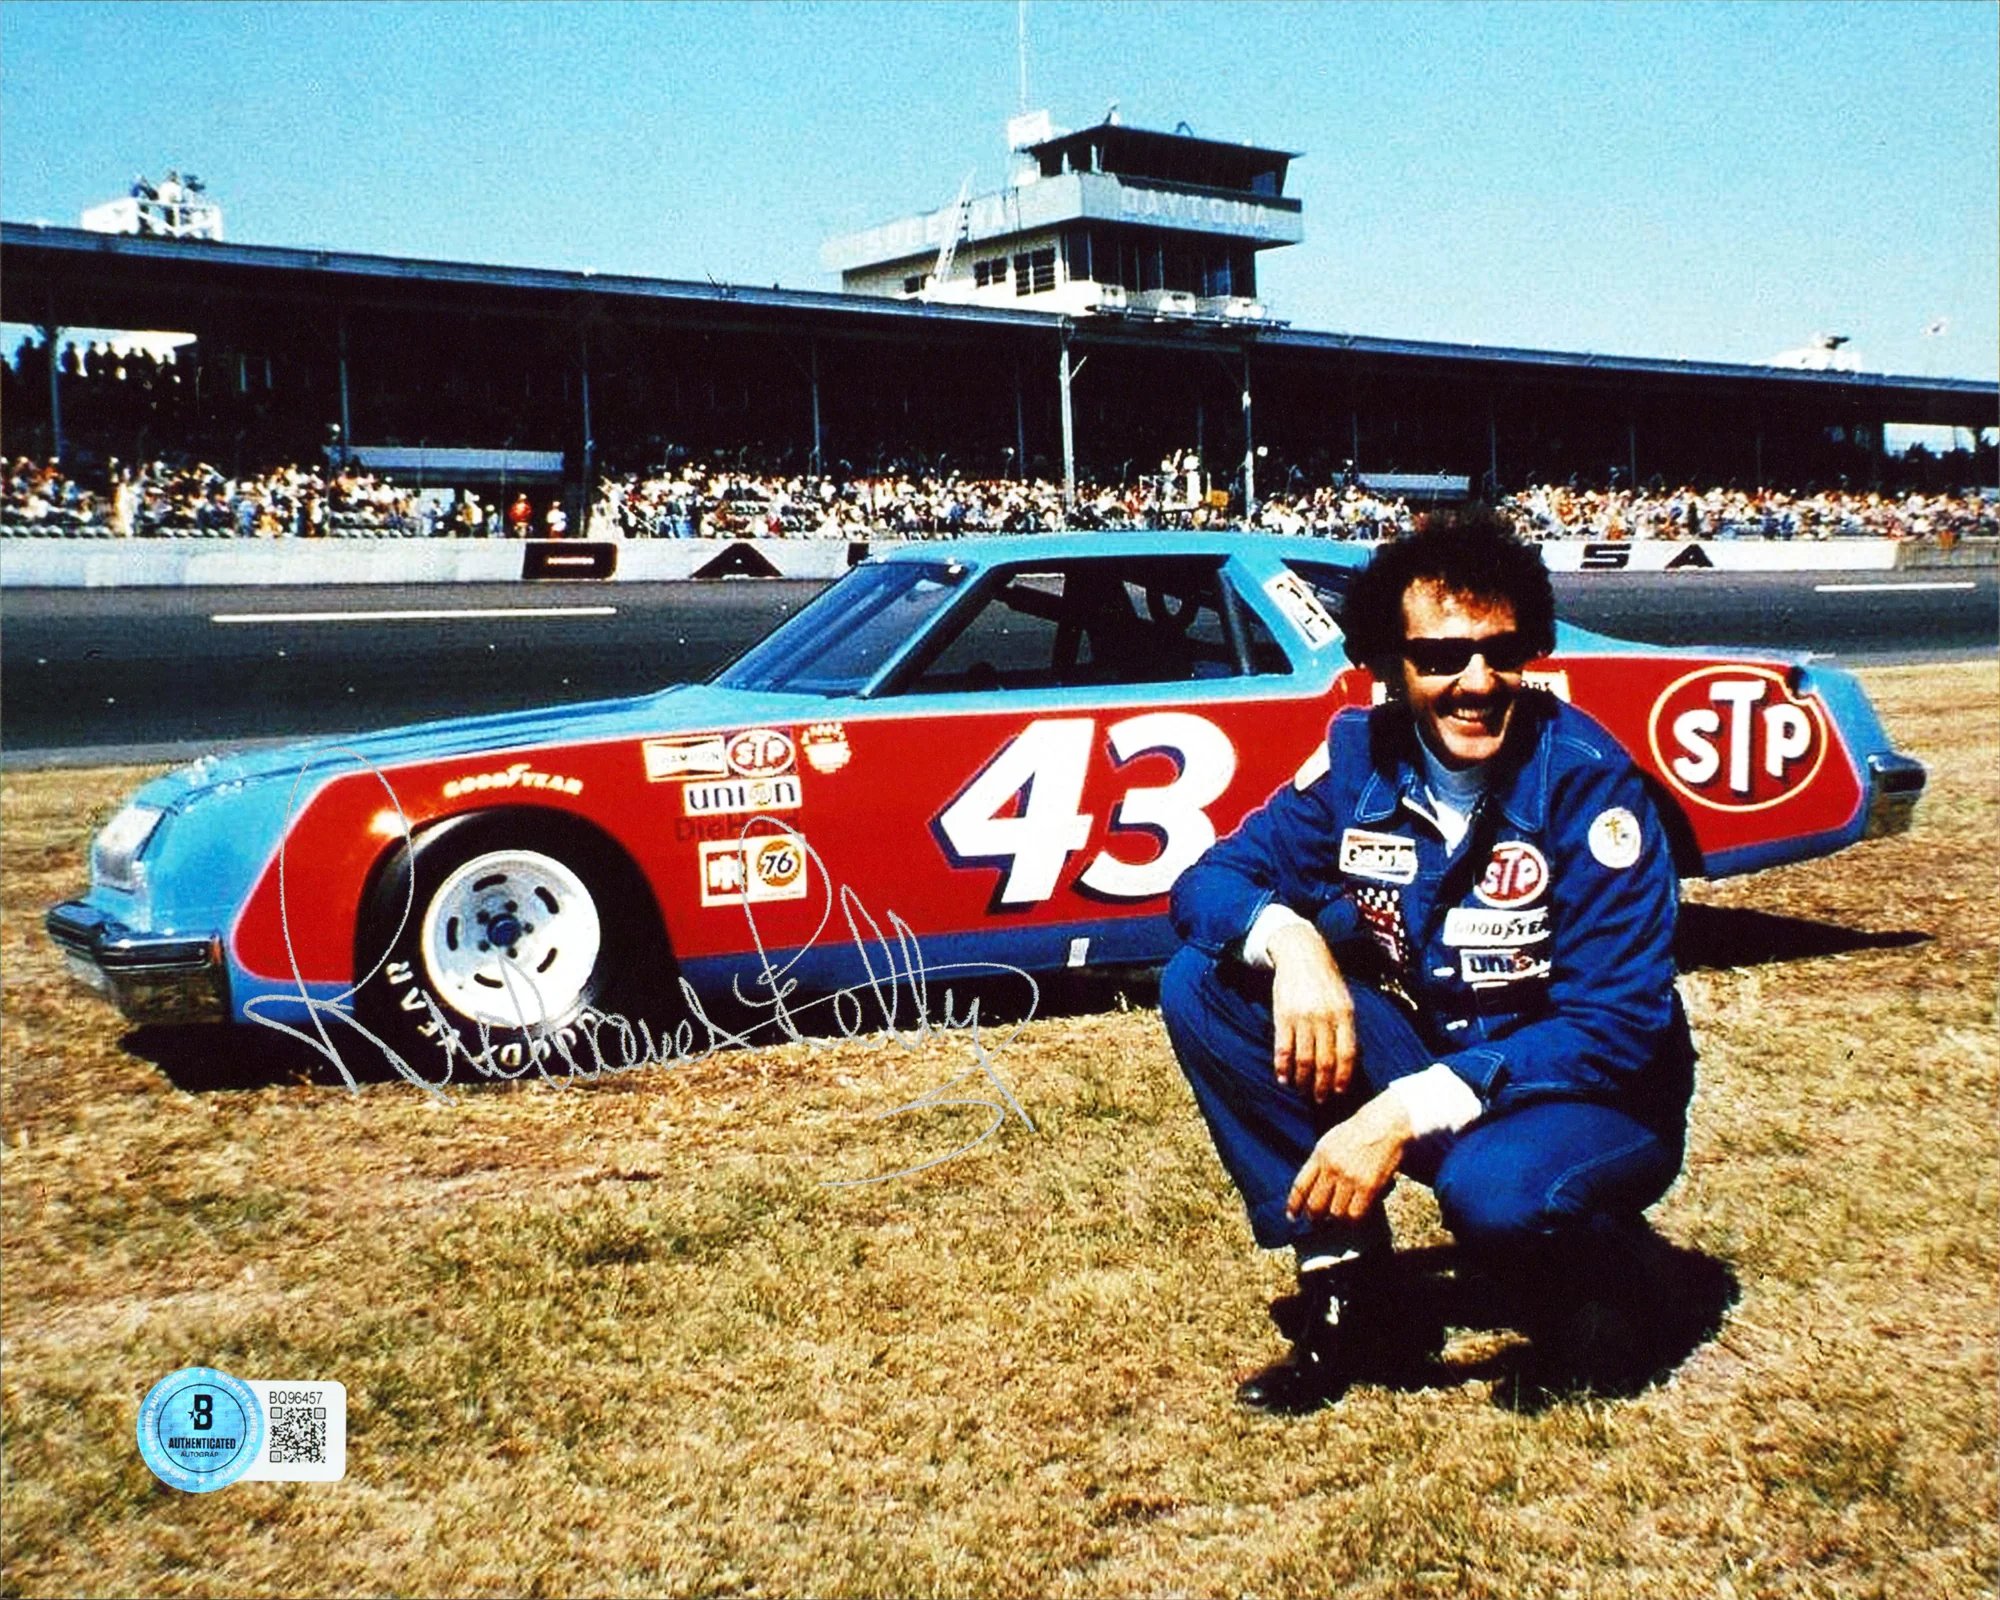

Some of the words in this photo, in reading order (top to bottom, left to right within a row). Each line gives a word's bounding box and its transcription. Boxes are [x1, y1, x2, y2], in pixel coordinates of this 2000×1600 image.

[1121, 185, 1267, 226] DAYTONA
[735, 733, 786, 769] STP
[1673, 680, 1811, 793] STP
[443, 763, 584, 798] GOODYEAR
[927, 711, 1237, 908] 43
[764, 851, 793, 874] 76
[1480, 851, 1542, 894] STP
